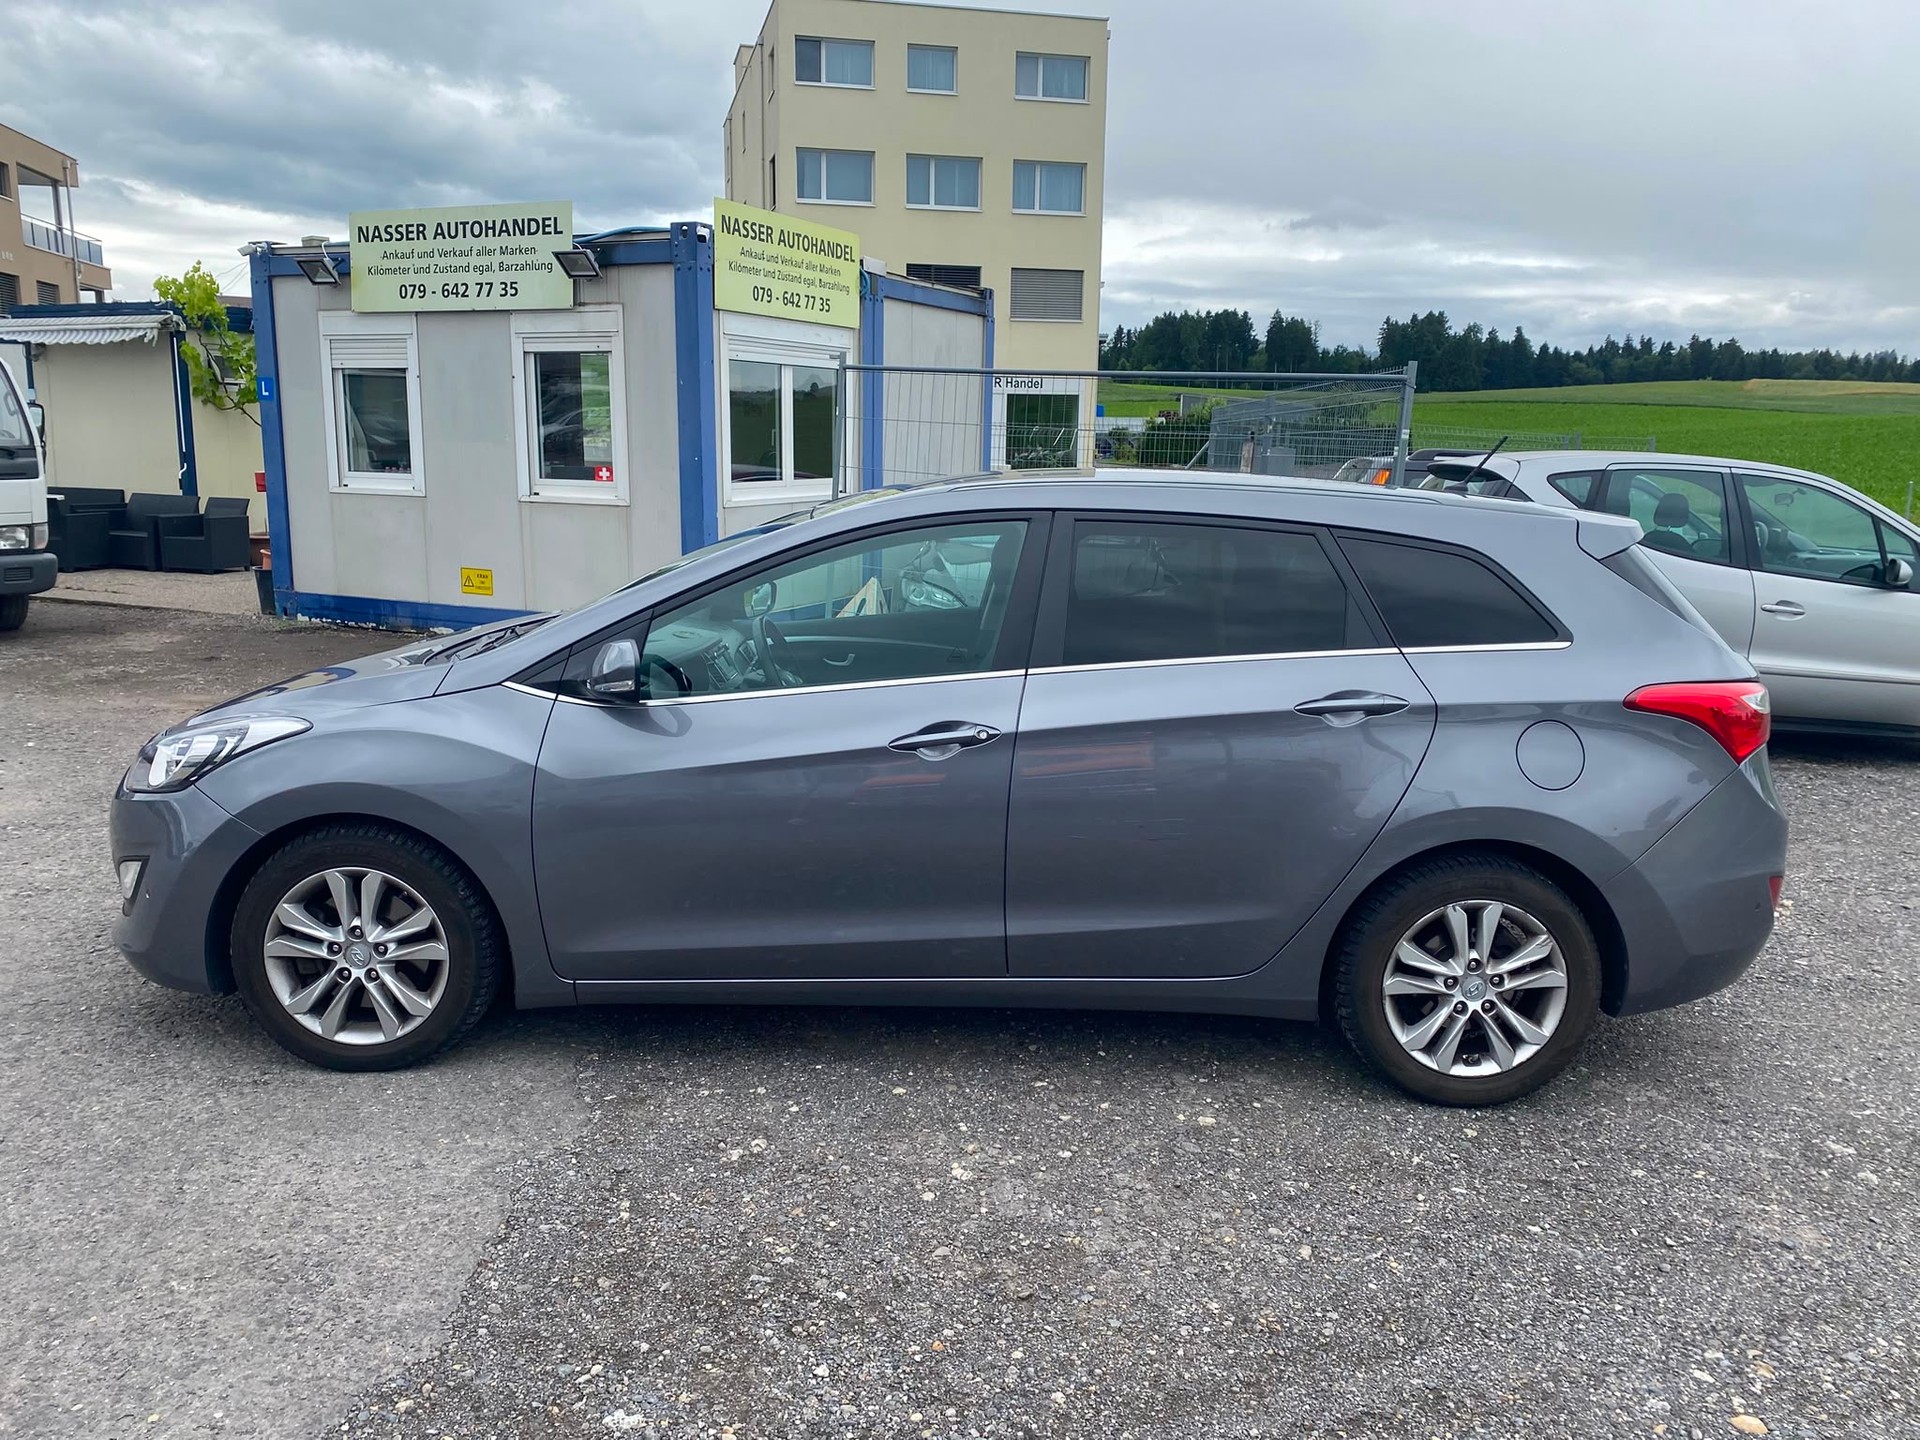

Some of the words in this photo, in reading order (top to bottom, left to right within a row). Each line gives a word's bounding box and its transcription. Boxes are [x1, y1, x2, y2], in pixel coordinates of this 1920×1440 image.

[357, 223, 427, 243] NASSER
[433, 216, 563, 240] AUTOHANDEL
[721, 214, 774, 244] NASSER
[777, 229, 855, 263] AUTOHANDEL
[382, 249, 415, 261] Ankauf
[417, 249, 435, 260] und
[437, 247, 474, 259] Verkauf
[476, 246, 496, 257] aller
[500, 244, 536, 256] Marken
[740, 246, 765, 261] Ankauf
[766, 253, 779, 265] und
[780, 255, 804, 269] Verkauf
[805, 260, 818, 272] aller
[819, 263, 841, 277] Marken
[367, 265, 411, 276] Kilometer
[413, 264, 430, 275] und
[433, 262, 470, 274] Zustand
[473, 261, 496, 275] egal,
[498, 260, 553, 274] Barzahlung
[728, 261, 762, 277] Kilometer
[763, 268, 776, 280] und
[777, 270, 801, 285] Zustand
[803, 277, 817, 289] egal,
[819, 278, 850, 295] Barzahlung
[399, 283, 427, 299] 079
[441, 282, 469, 298] 642
[475, 282, 494, 297] 77
[500, 281, 518, 297] 35
[752, 285, 773, 304] 079
[782, 291, 801, 308] 642
[804, 294, 817, 310] 77
[819, 298, 831, 313] 35
[261, 381, 270, 396] L
[1005, 377, 1043, 389] Handel
